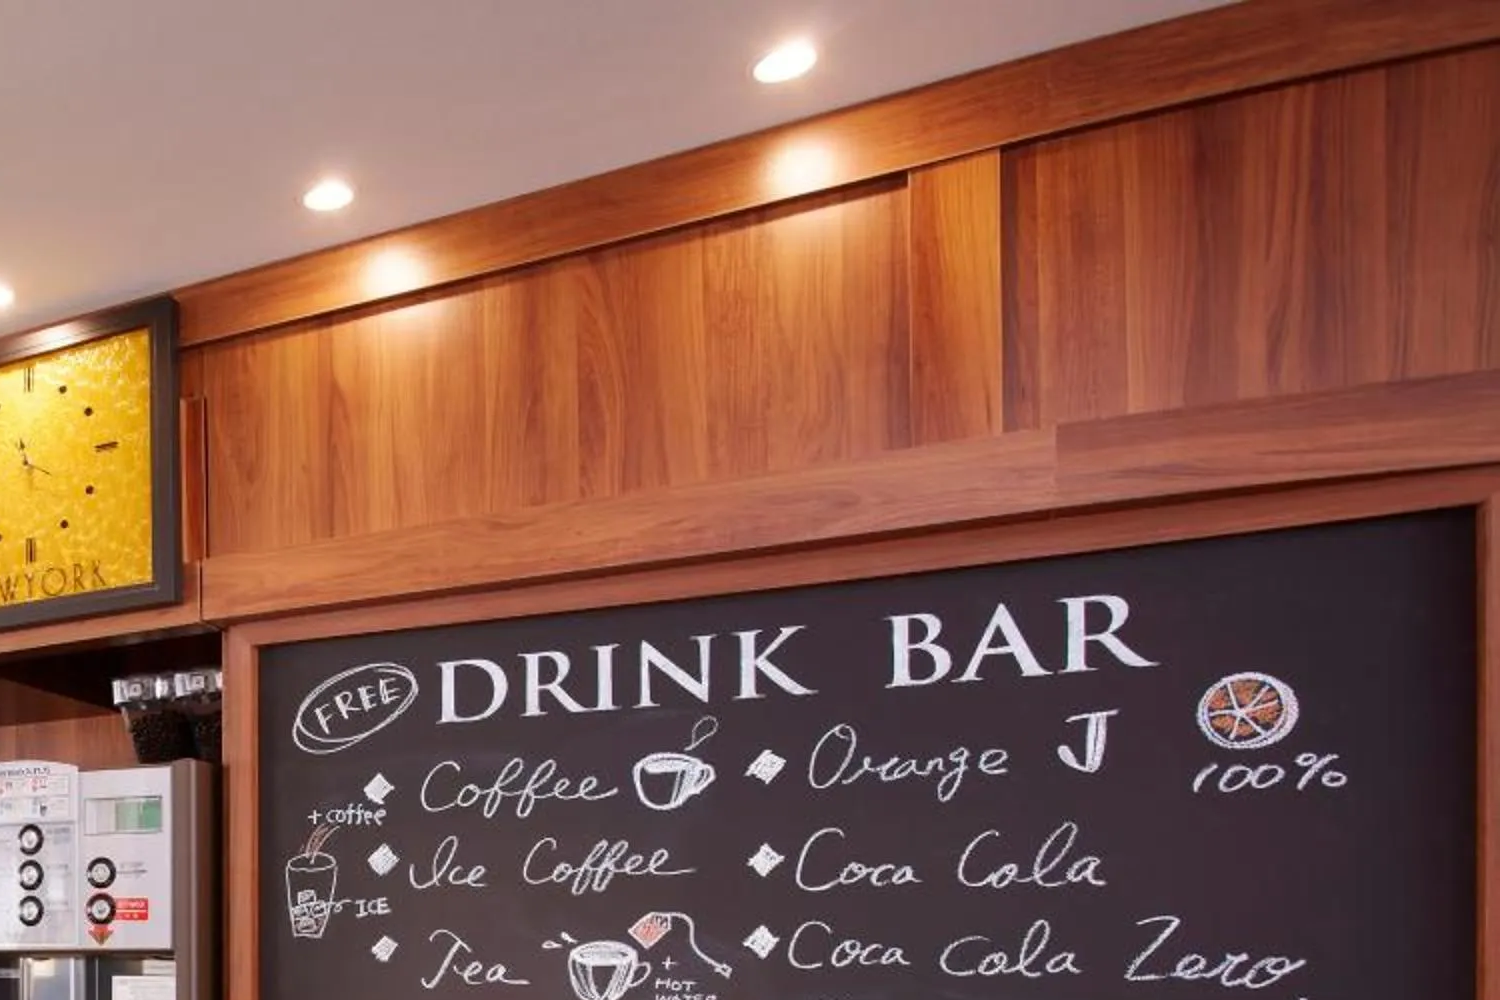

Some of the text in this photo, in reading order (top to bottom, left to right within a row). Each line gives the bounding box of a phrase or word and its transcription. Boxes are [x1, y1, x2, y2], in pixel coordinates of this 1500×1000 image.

[436, 595, 1159, 724] DRINK BAR
[314, 678, 400, 734] FREE
[809, 709, 1119, 802] Orange J
[1193, 753, 1347, 793] 100%
[420, 758, 618, 818] Coffee
[409, 836, 695, 895] Ice Coffee
[796, 822, 1106, 891] Coca Cola
[355, 897, 391, 918] ICE
[421, 929, 530, 989] Tea
[788, 921, 911, 969] Coca
[1124, 916, 1306, 988] Zero
[655, 978, 696, 992] HOT
